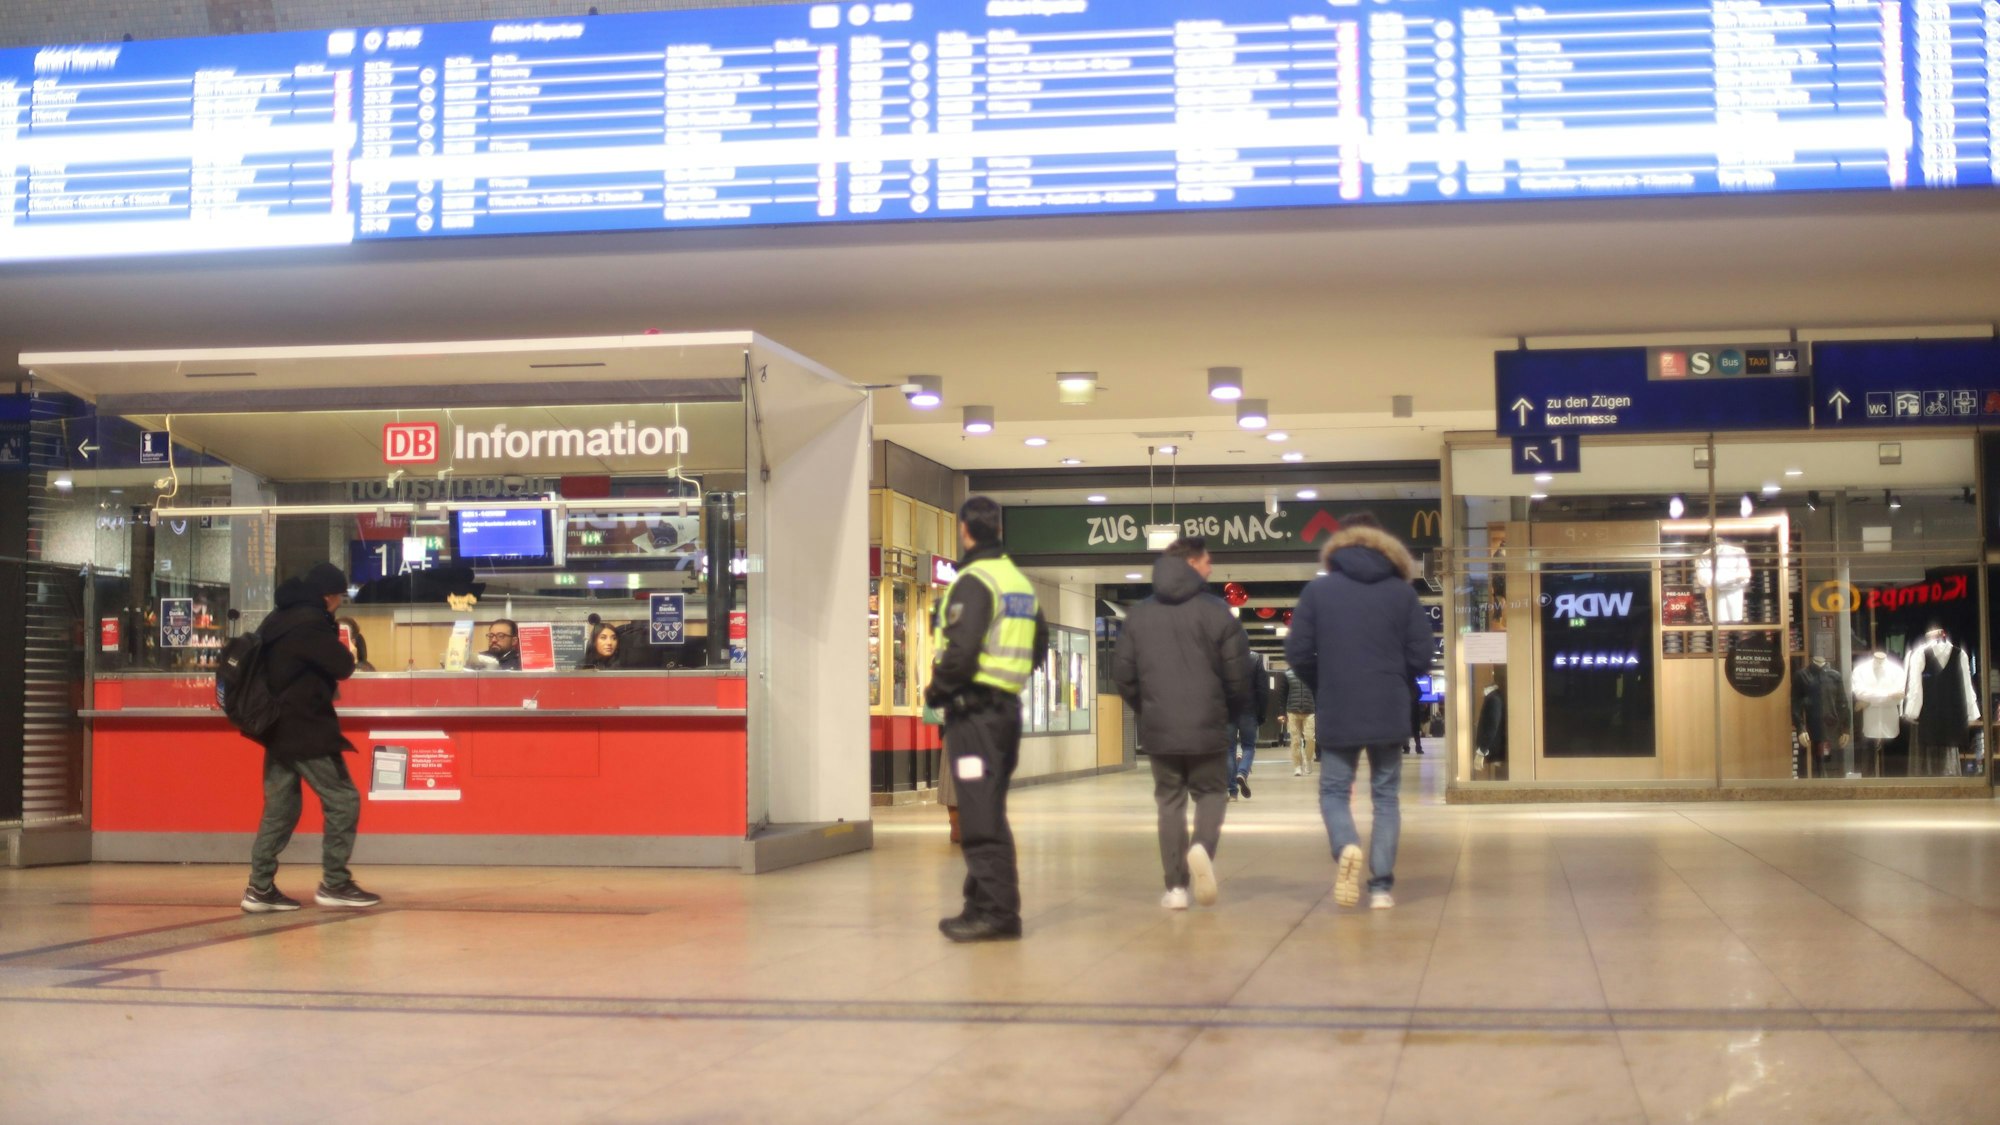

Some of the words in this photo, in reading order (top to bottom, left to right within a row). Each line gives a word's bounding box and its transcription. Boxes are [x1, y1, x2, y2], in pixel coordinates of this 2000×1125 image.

[1691, 352, 1711, 375] S
[1722, 357, 1738, 367] Bus
[1748, 356, 1768, 366] TAXI
[1547, 398, 1561, 409] zu
[1565, 396, 1588, 408] den
[1592, 395, 1631, 411] Zügen
[1868, 404, 1887, 415] WC
[1546, 412, 1618, 426] koelnmesse
[390, 429, 433, 457] DB
[454, 419, 689, 460] Information
[1550, 436, 1563, 462] 1
[1087, 514, 1137, 546] ZUG
[375, 543, 387, 576] 1
[1556, 656, 1639, 665] ETERNA
